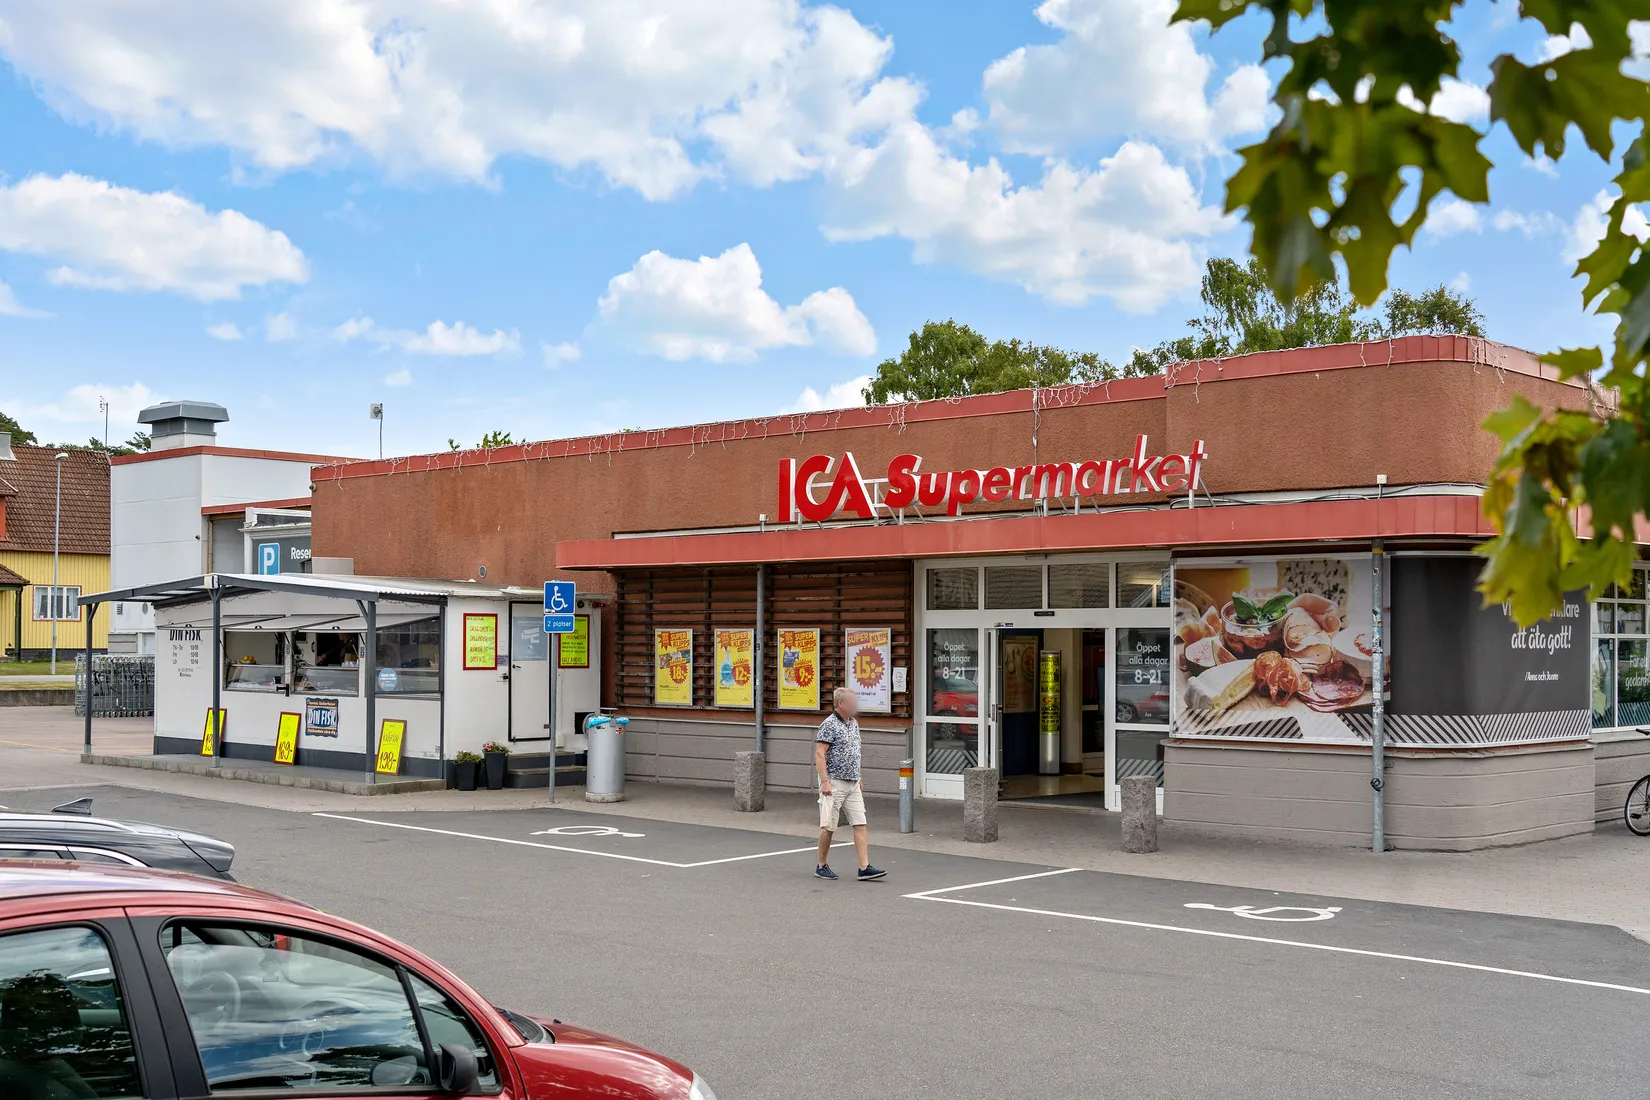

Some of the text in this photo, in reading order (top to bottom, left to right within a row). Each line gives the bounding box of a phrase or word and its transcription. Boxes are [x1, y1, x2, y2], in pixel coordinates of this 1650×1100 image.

[779, 434, 1207, 522] ICA Supermarket
[263, 547, 276, 575] P
[552, 620, 572, 628] platser
[671, 632, 687, 640] SUPER
[731, 632, 748, 640] SUPER
[794, 631, 813, 640] SUPER
[847, 633, 869, 644] SUPER
[1511, 624, 1572, 655] att äta gott!
[944, 641, 965, 652] Öppet
[1136, 641, 1161, 654] Öppet
[938, 654, 971, 664] alla dagar
[1129, 655, 1168, 667] alla dagar
[672, 666, 688, 680] 18:-
[735, 666, 750, 681] 12:-
[856, 655, 883, 679] 15:-
[942, 666, 966, 679] 8-21
[799, 667, 812, 682] 9:-
[1134, 669, 1162, 684] 8-21
[308, 709, 337, 726] DIN FISK
